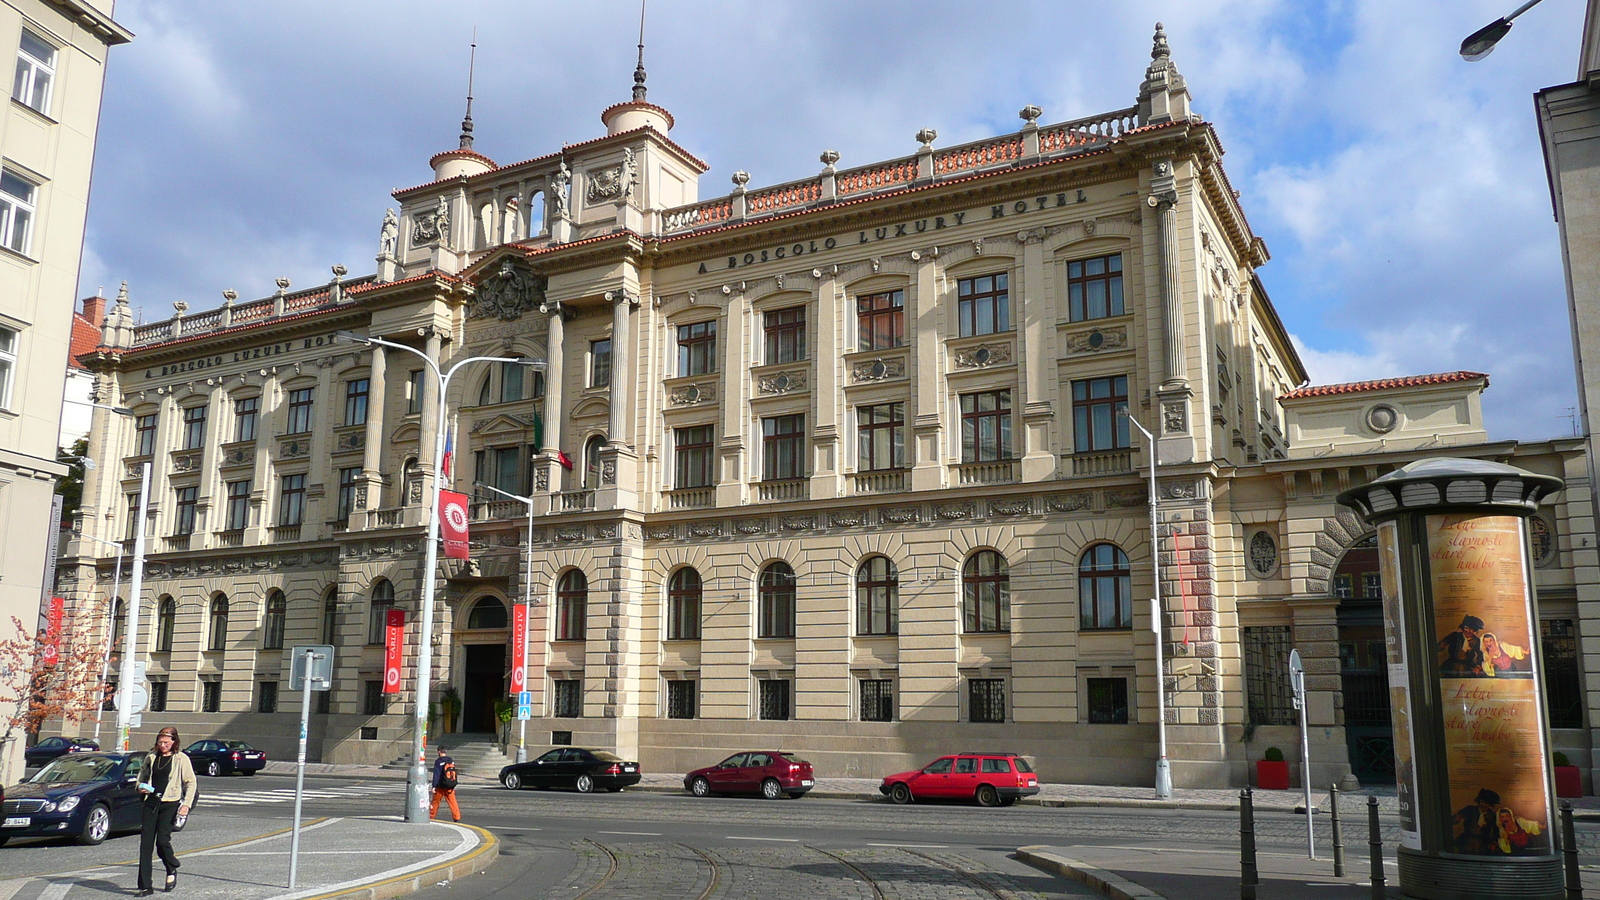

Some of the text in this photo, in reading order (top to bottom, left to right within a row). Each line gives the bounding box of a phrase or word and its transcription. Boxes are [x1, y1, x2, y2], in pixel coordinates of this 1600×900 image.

[698, 190, 1087, 274] A BOSCOLO LUXURY HOTEL
[145, 370, 152, 378] A
[162, 356, 222, 376] BOSCOLO
[233, 342, 291, 362] LUXURY
[1447, 533, 1502, 546] slavnosti
[391, 617, 397, 626] IV
[517, 611, 523, 622] IV
